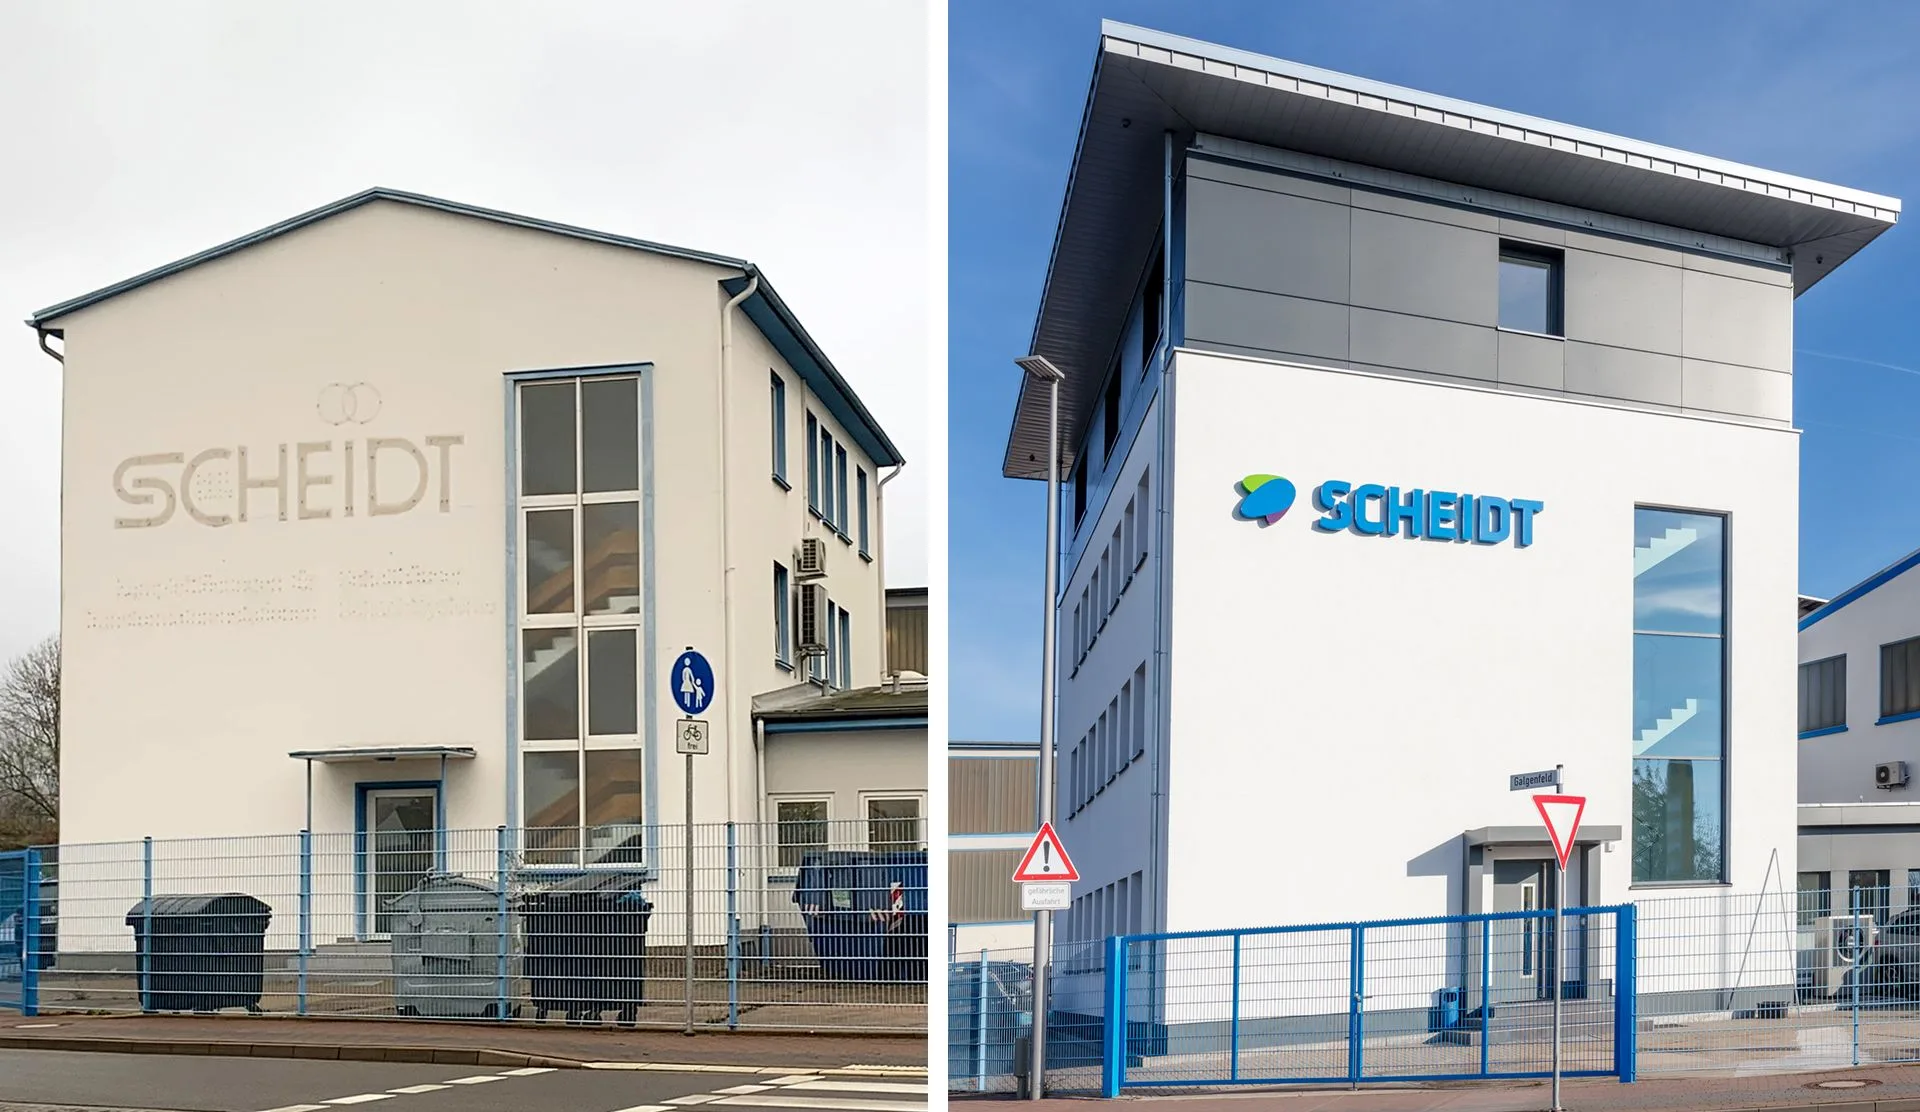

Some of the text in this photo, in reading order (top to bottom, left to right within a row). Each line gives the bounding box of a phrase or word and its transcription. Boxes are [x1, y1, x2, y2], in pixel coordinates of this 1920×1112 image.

[113, 434, 465, 529] SCHEIDT
[1317, 479, 1545, 549] SCHEIDT
[687, 742, 698, 750] frei
[1513, 772, 1553, 787] Galgenfeld
